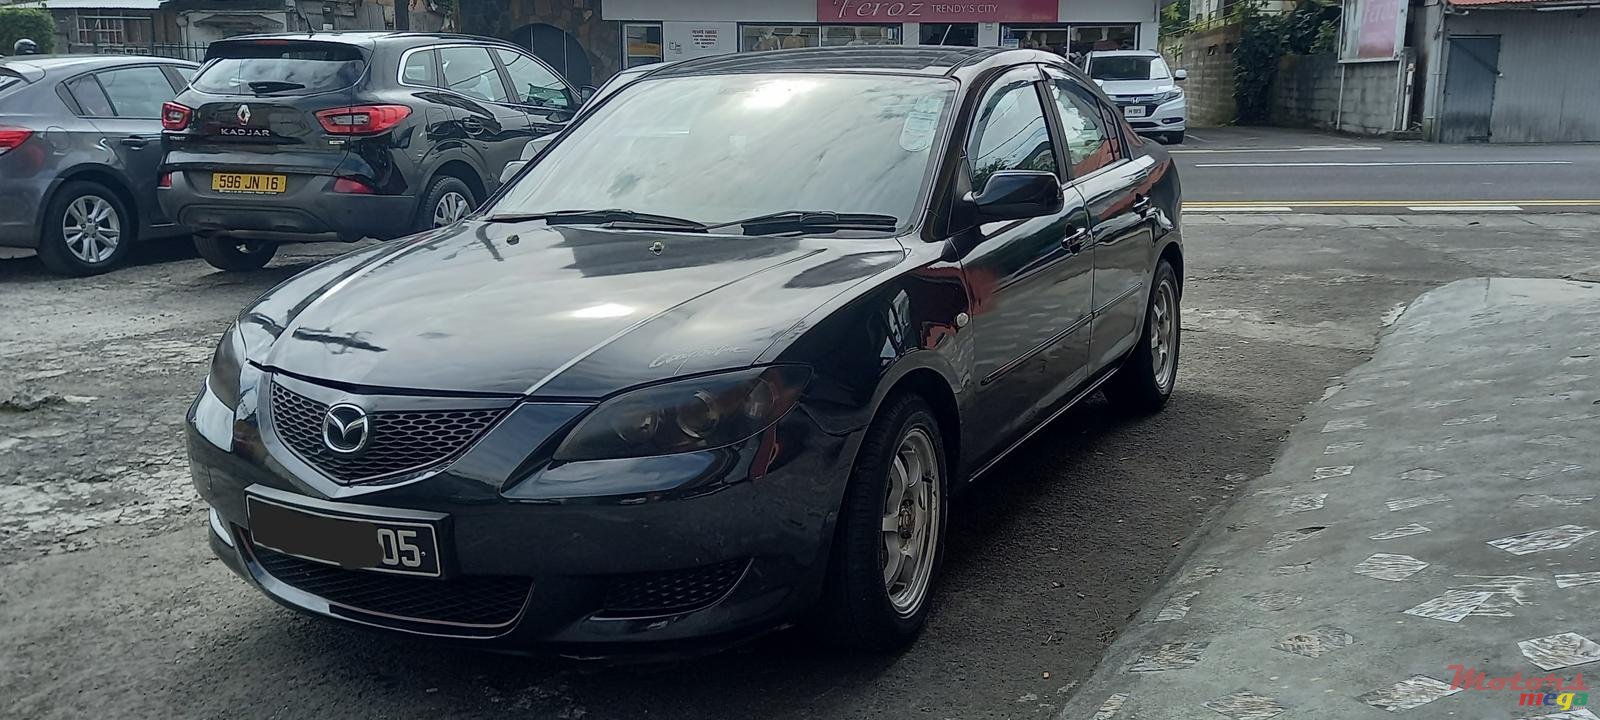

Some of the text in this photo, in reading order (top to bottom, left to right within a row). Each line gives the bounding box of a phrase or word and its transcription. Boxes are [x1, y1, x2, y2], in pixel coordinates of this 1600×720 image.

[931, 4, 975, 13] TRENDY'S
[977, 4, 999, 13] CITY
[221, 128, 271, 137] KADJAR
[219, 175, 279, 190] 596 JN 16
[377, 528, 422, 568] 05
